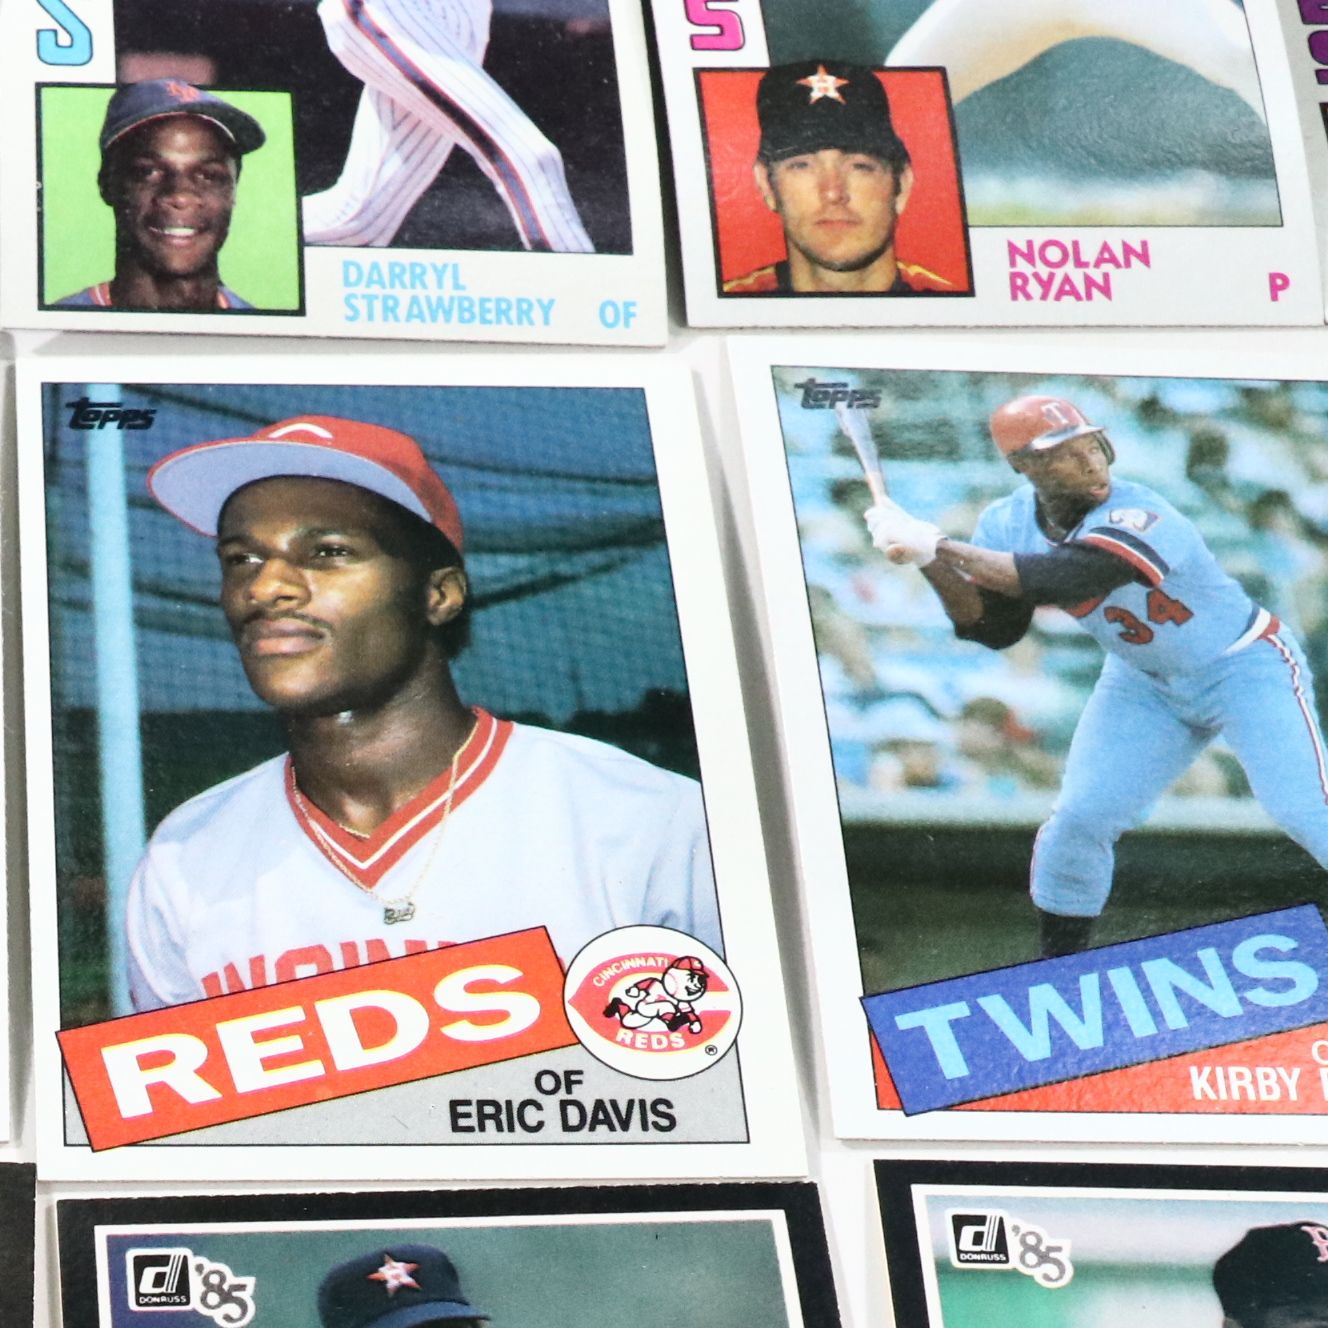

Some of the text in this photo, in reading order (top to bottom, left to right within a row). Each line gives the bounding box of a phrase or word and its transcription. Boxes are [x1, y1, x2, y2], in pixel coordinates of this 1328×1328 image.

[1007, 238, 1152, 271] NOLAN
[342, 259, 468, 291] DARRYL
[1009, 271, 1291, 303] RYAN P
[343, 293, 638, 329] STRAWBERRY OF
[1103, 587, 1195, 645] 34
[592, 956, 670, 988] CINCINNATI
[893, 933, 1320, 1081] TWINS
[100, 963, 543, 1120] REDS
[615, 1028, 686, 1050] REDS
[533, 1068, 584, 1096] OF
[1188, 1065, 1302, 1101] KIRBY
[448, 1097, 677, 1134] ERIC DAVIS
[959, 1252, 1008, 1263] DONRUSS
[138, 1295, 187, 1305] DONRUSS
